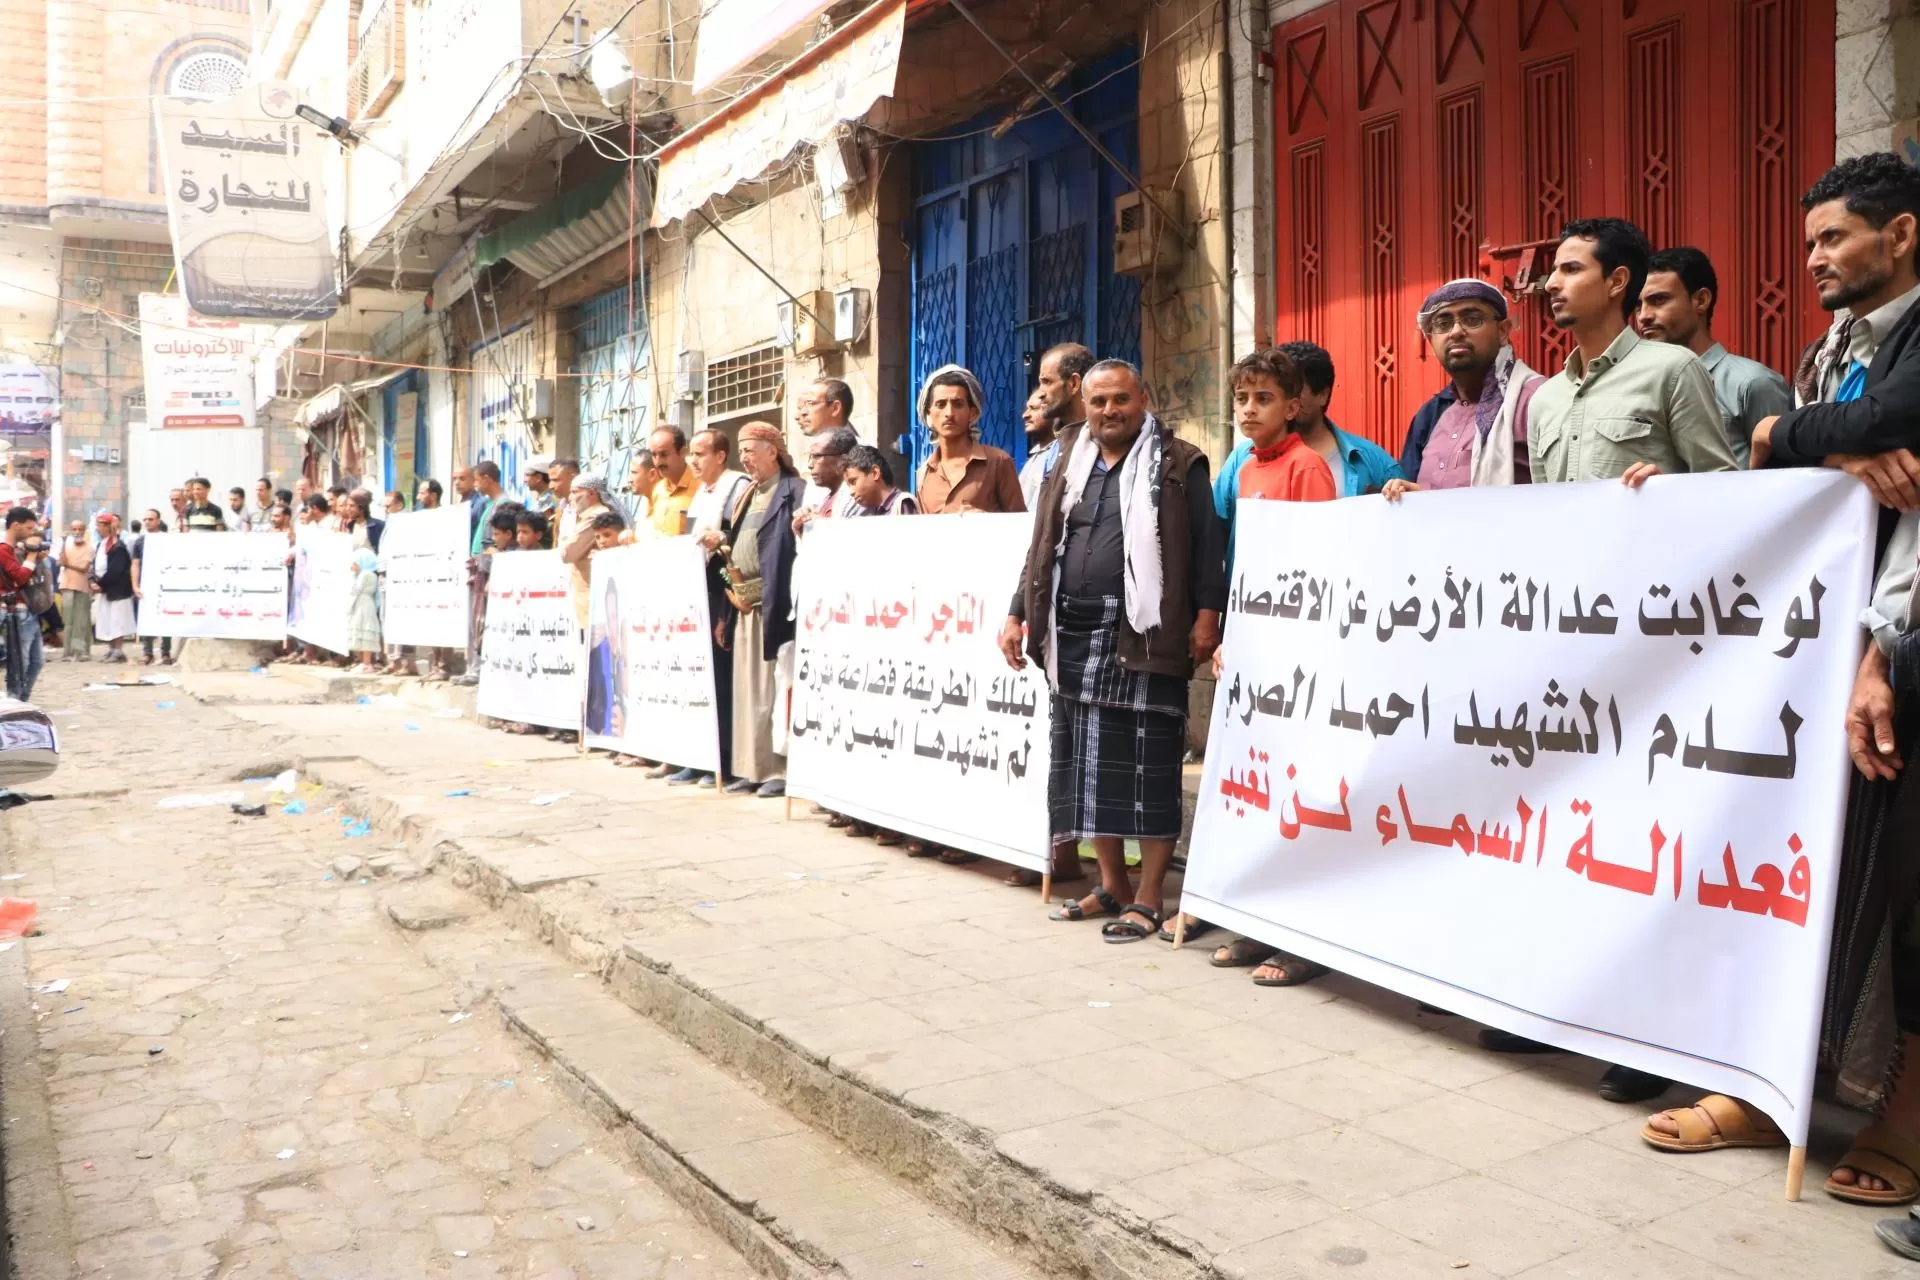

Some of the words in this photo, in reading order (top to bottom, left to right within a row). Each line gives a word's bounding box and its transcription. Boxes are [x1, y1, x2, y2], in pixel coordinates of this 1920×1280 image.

[179, 169, 310, 215] للتجارة
[924, 593, 984, 643] التاجر
[1340, 579, 1366, 638] عن
[1377, 566, 1482, 642] الأرض
[1500, 572, 1618, 634] عدالة
[1638, 572, 1763, 655] غابت
[1774, 575, 1826, 658] لو
[838, 655, 896, 696] فضاعة
[903, 661, 976, 714] الطريقة
[1226, 666, 1316, 726] الصرم
[845, 710, 903, 759] اليمن
[1330, 683, 1429, 739] احمد
[1454, 679, 1621, 768] الشهيد
[914, 722, 998, 776] تشهدها
[1007, 739, 1031, 785] لم
[1280, 764, 1352, 840] لن
[1376, 784, 1546, 866] السماء
